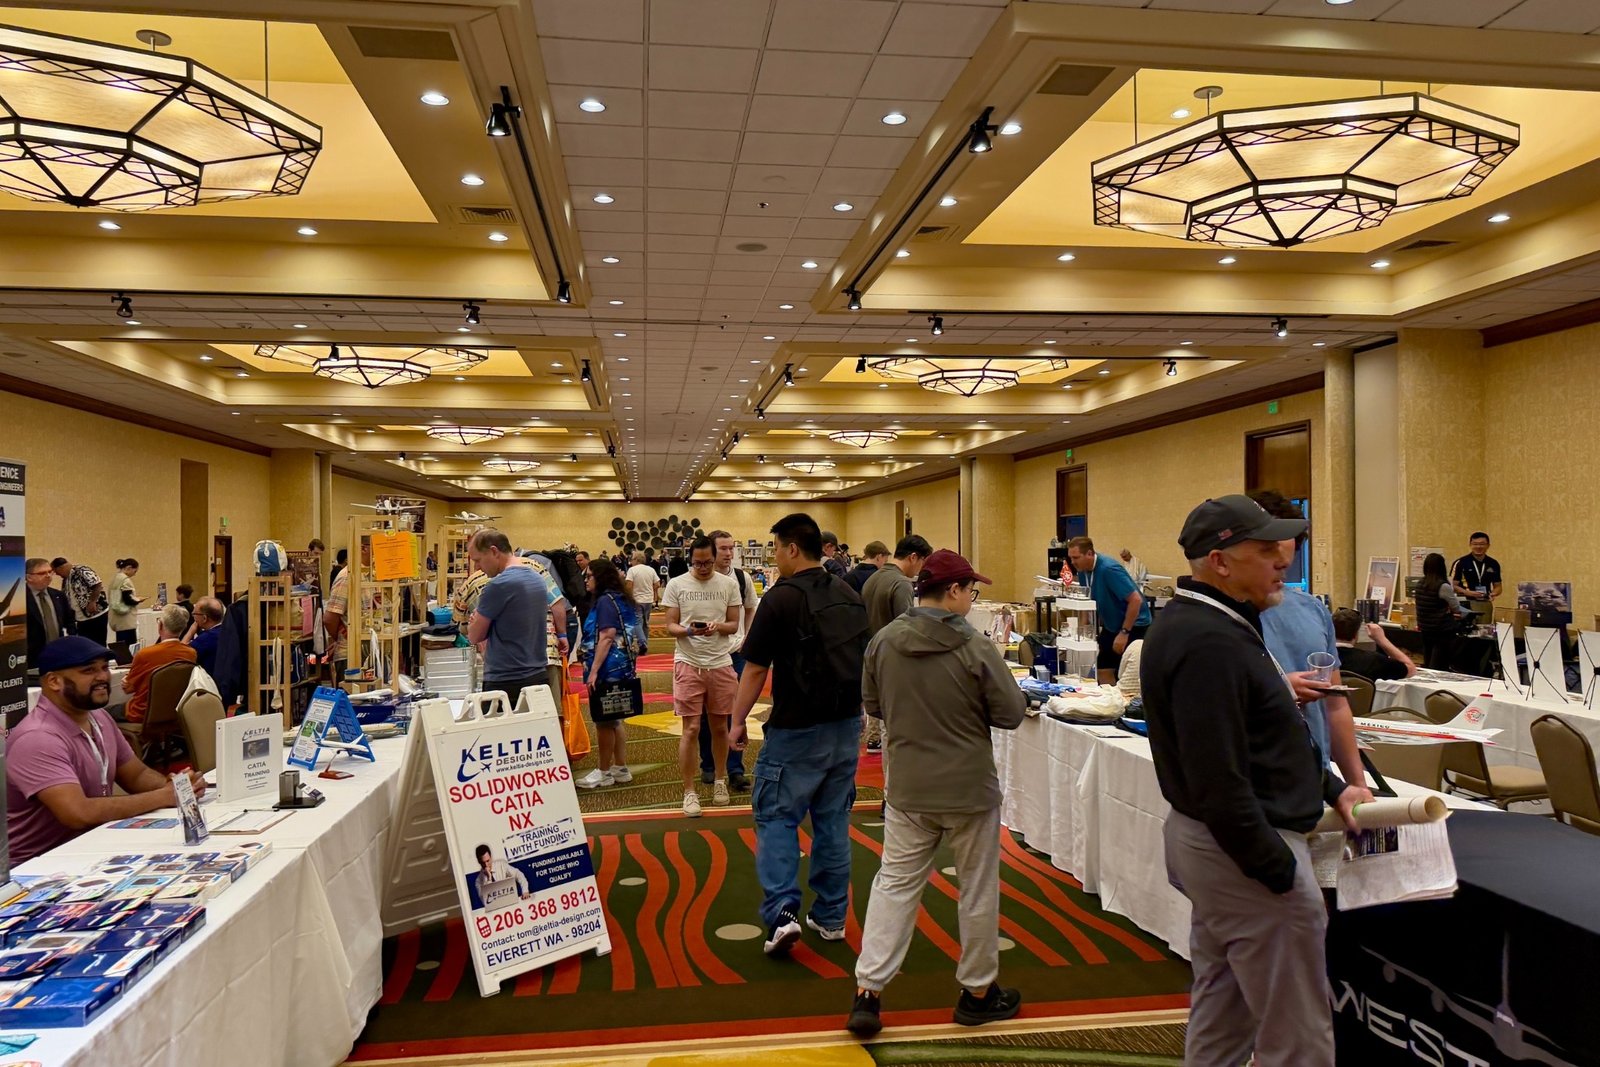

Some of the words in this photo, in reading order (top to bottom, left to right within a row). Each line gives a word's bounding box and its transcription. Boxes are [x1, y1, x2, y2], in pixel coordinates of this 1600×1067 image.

[0, 466, 19, 480] ENCE
[0, 481, 24, 492] NGINEERS
[3, 677, 23, 688] CLIENTS
[1, 700, 27, 714] ENGINEERS
[243, 727, 270, 738] KELTIA
[461, 735, 550, 764] KELTIA
[247, 761, 266, 770] CATIA
[495, 758, 554, 773] www.keltia-design.com
[496, 753, 533, 766] DESIGN
[536, 750, 552, 759] INC
[243, 769, 270, 779] TRAINING
[449, 765, 570, 803] SOLIDWORKS
[491, 790, 544, 815] CATIA
[508, 811, 535, 832] NX
[520, 824, 560, 843] TRAINING
[510, 842, 533, 856] WITH
[531, 858, 556, 869] FUNDING
[556, 849, 584, 862] AVAILABLE
[536, 869, 548, 878] FOR
[548, 864, 566, 874] THOSE
[566, 860, 580, 869] WHO
[549, 872, 572, 883] QUALIFY
[487, 886, 515, 898] KELTIA
[493, 908, 524, 932] 206
[528, 898, 557, 921] 368
[560, 885, 597, 910] 9812
[481, 934, 516, 951] Contact:
[516, 907, 601, 940] tom@keltia-design.com
[486, 939, 541, 967] EVERETT
[543, 932, 564, 947] WA
[571, 919, 602, 938] 98204
